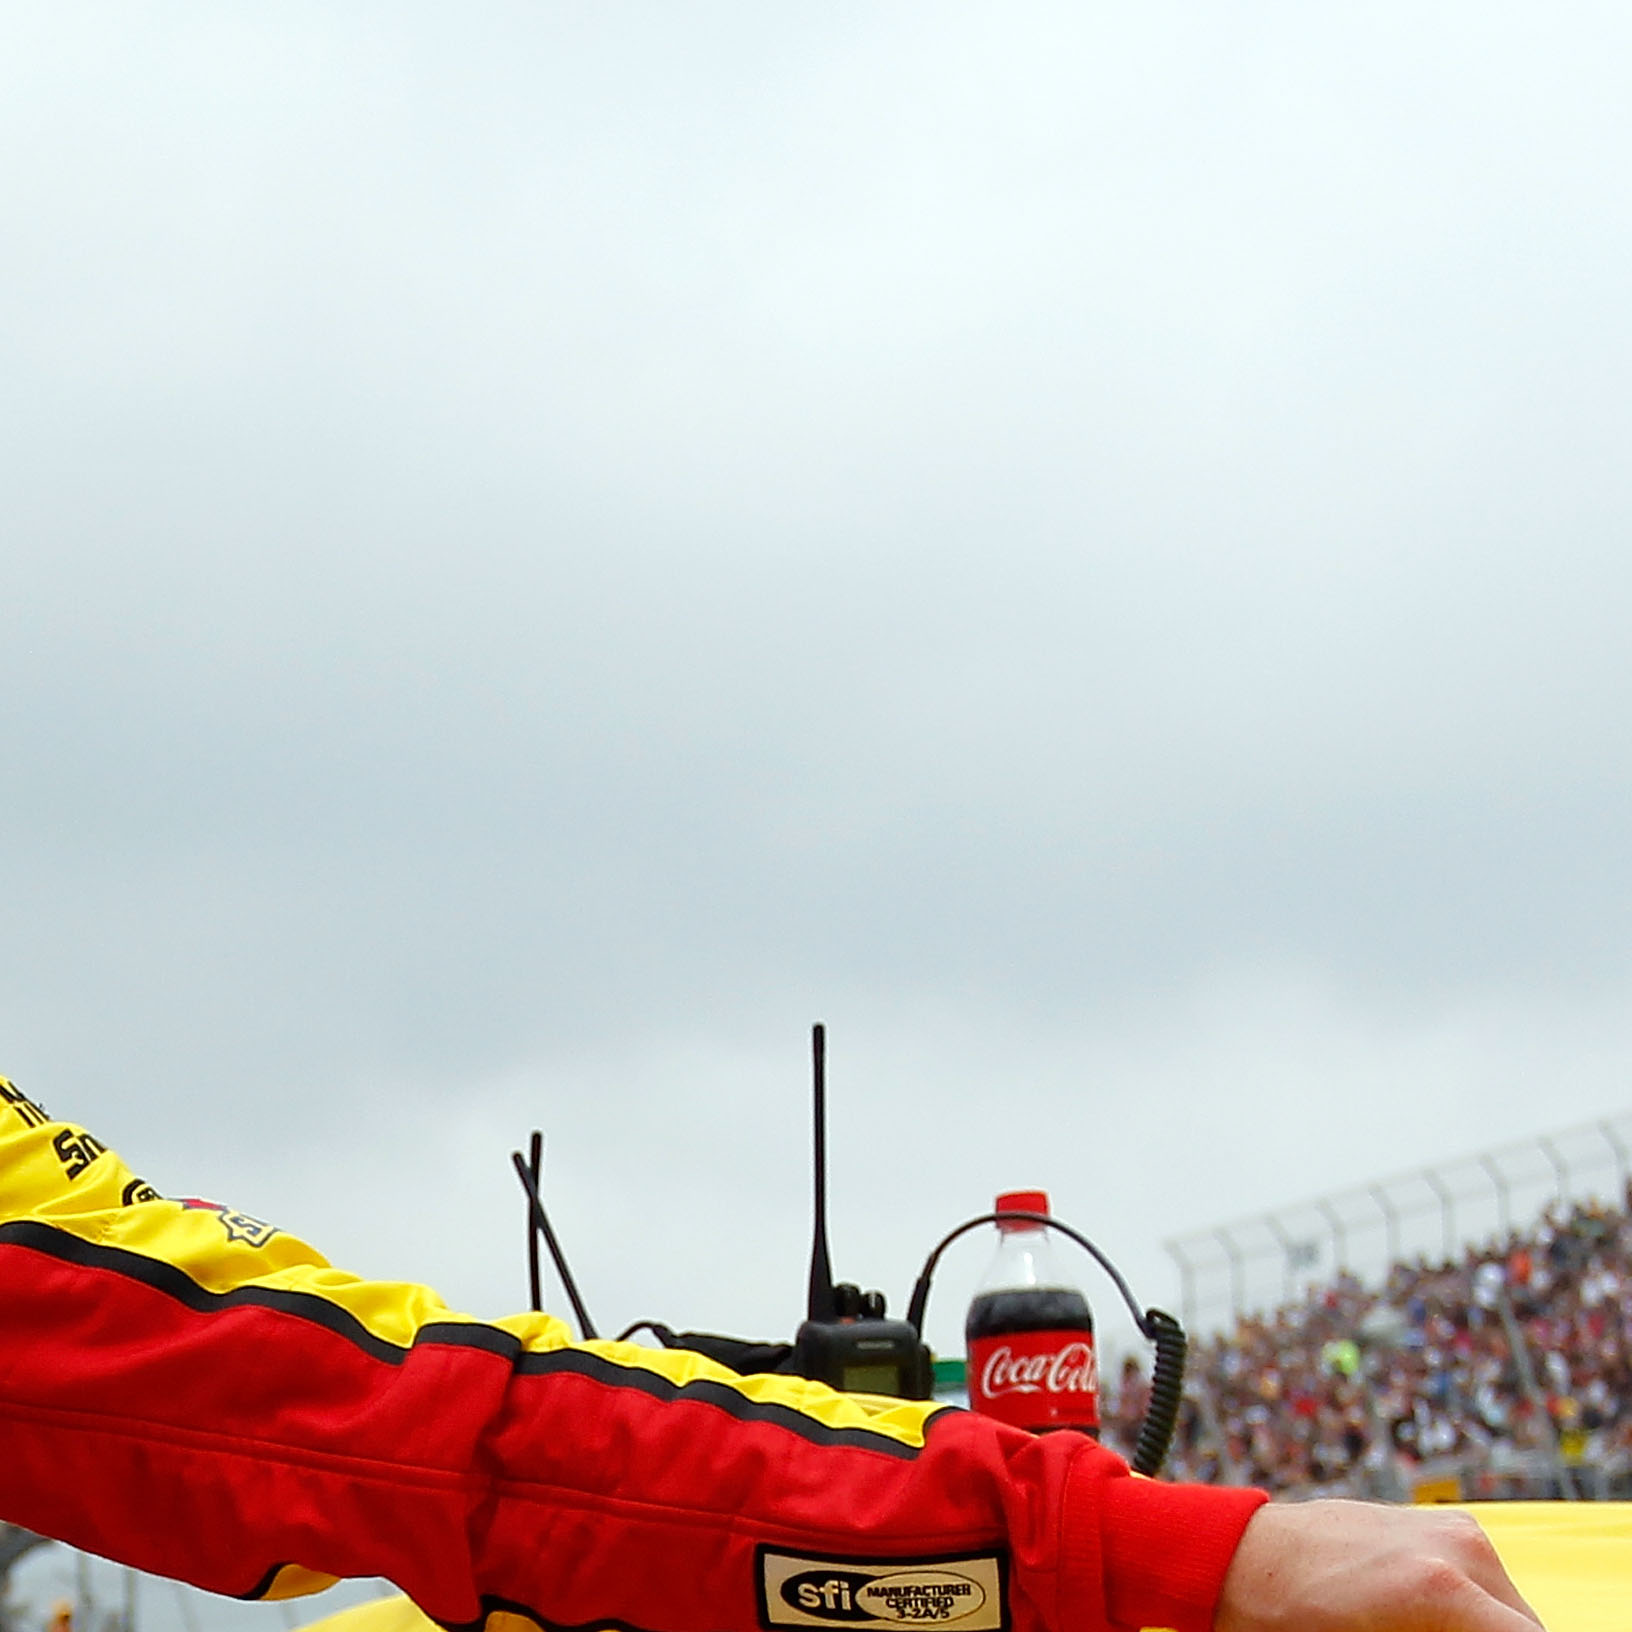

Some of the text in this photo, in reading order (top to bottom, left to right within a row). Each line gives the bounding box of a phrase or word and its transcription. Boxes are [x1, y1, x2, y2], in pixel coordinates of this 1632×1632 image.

[797, 1579, 852, 1611] sfi
[867, 1583, 972, 1599] MANUFACTURER
[885, 1597, 955, 1609] CERTIFIED
